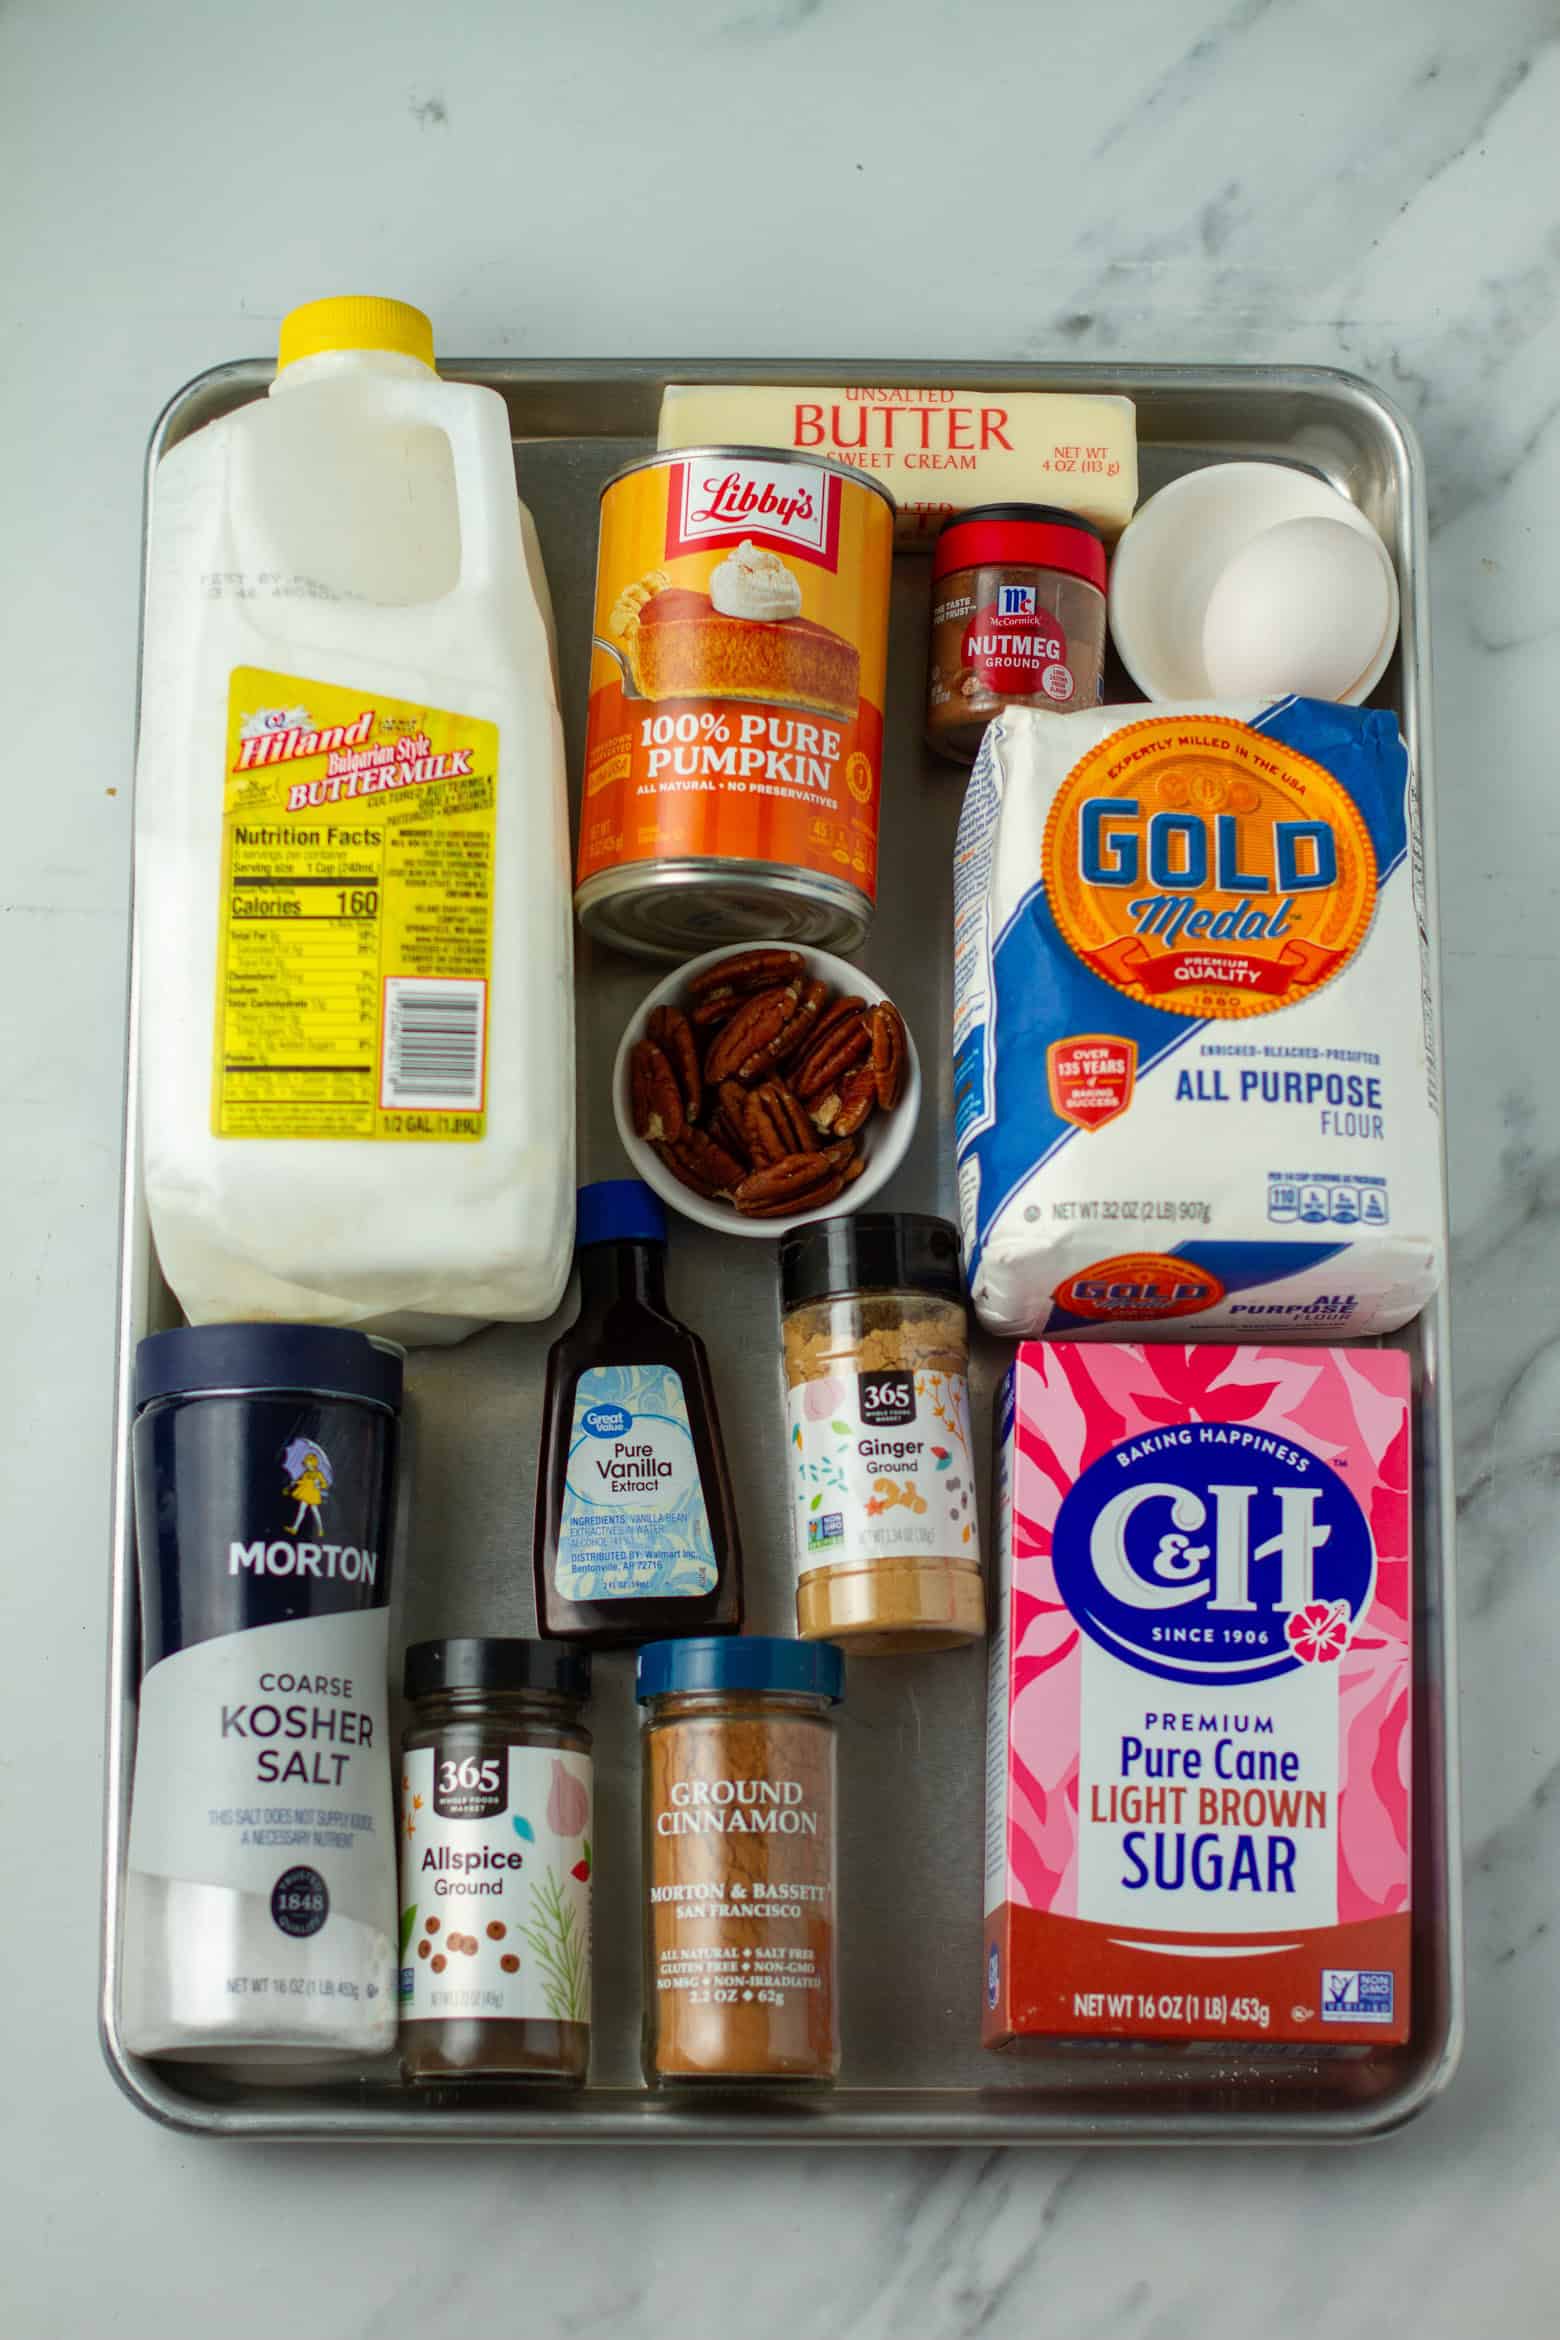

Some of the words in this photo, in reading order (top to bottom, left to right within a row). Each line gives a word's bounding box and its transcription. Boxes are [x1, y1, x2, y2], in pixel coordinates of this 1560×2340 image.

[845, 386, 954, 403] UNSALTED
[793, 404, 1014, 450] BUTTER
[904, 454, 977, 469] CREAM
[1054, 447, 1082, 460] NET
[1086, 448, 1109, 460] WT
[1042, 459, 1049, 472] 4
[1054, 461, 1077, 473] OZ
[690, 472, 813, 526] Libby's
[989, 616, 1041, 626] McCormick
[968, 635, 1060, 660] NUTMEG
[985, 657, 1040, 669] GROUND
[233, 711, 376, 773] Hiland
[641, 713, 730, 746] 100%
[740, 714, 841, 761] PURE
[327, 743, 397, 777] Bulgarian
[396, 732, 432, 762] Style
[647, 747, 833, 790] PUMPKIN
[1106, 737, 1173, 780] EXPERTLY
[1178, 736, 1231, 750] MILLED
[1236, 745, 1249, 758] IN
[1253, 754, 1279, 776] THE
[1280, 772, 1307, 796] USA
[286, 749, 473, 812] BUTTERMILK
[637, 783, 657, 795] ALL
[659, 780, 716, 791] NATURAL
[727, 782, 746, 792] NO
[749, 783, 839, 810] PRESERVATIVES
[234, 827, 320, 846] Nutrition
[327, 828, 382, 846] Facts
[1077, 796, 1339, 895] GOLD
[232, 896, 302, 915] Calories
[337, 890, 378, 915] 160
[1126, 895, 1295, 949] Medal
[1183, 957, 1249, 968] PREMIUM
[1173, 966, 1262, 983] QUALITY
[1073, 1048, 1110, 1060] OVER
[1058, 1062, 1080, 1076] 135
[1082, 1059, 1125, 1075] YEARS
[1176, 1069, 1230, 1101] ALL
[1240, 1070, 1383, 1110] PURPOSE
[1320, 1110, 1384, 1141] FLOUR
[1052, 1201, 1077, 1220] NET
[1080, 1201, 1099, 1219] WT
[1102, 1201, 1120, 1220] 32
[1121, 1201, 1138, 1220] OZ
[1179, 1201, 1212, 1224] 907g
[1071, 1280, 1211, 1300] GOLD
[1313, 1295, 1360, 1305] ALL
[1229, 1304, 1354, 1315] PURPOSE
[864, 1382, 910, 1409] 365
[587, 1412, 624, 1425] Great
[596, 1423, 625, 1432] Value
[614, 1443, 653, 1458] Pure
[858, 1438, 925, 1459] Ginger
[1115, 1429, 1193, 1468] BAKING
[1200, 1428, 1311, 1473] HAPPINESS
[595, 1458, 673, 1479] Vanilla
[866, 1458, 919, 1474] Ground
[611, 1480, 659, 1493] Extract
[571, 1551, 626, 1562] DISTRIBUTED
[1090, 1482, 1332, 1612] C&H
[228, 1541, 379, 1586] MORTON
[1151, 1627, 1215, 1643] SINCE
[1224, 1628, 1270, 1645] 1906
[259, 1673, 353, 1699] COARSE
[221, 1704, 374, 1749] KOSHER
[1145, 1712, 1274, 1734] PREMIUM
[255, 1750, 350, 1787] SALT
[1120, 1736, 1202, 1780] Pure
[1214, 1738, 1300, 1782] Cane
[438, 1756, 500, 1793] 365
[670, 1780, 803, 1806] GROUND
[1091, 1785, 1188, 1825] LIGHT
[1199, 1787, 1328, 1829] BROWN
[657, 1809, 818, 1836] CINNAMON
[421, 1847, 524, 1876] Allspice
[1120, 1831, 1297, 1893] SUGAR
[433, 1878, 504, 1896] Ground
[650, 1884, 725, 1903] MORTON
[730, 1884, 748, 1900] &
[753, 1883, 826, 1902] BASSETT
[278, 1893, 323, 1912] 1848
[676, 1904, 706, 1920] SAN
[709, 1904, 802, 1919] FRANCISCO
[660, 1951, 678, 1961] ALL
[680, 1948, 738, 1960] NATURAL
[755, 1948, 786, 1959] SALT
[660, 1962, 703, 1974] GLUTEN
[706, 1961, 738, 1973] FREE
[754, 1961, 816, 1973] NON-GMO
[714, 1975, 821, 1988] NON-IRRADIATED
[1360, 1975, 1389, 1985] NON
[1360, 1984, 1390, 1995] GMO
[714, 1989, 738, 2002] OZ
[758, 1990, 785, 2006] 62g
[1074, 1993, 1104, 2017] NET
[1107, 1994, 1134, 2018] WT
[1137, 1994, 1156, 2019] 16
[1158, 1995, 1184, 2020] OZ
[1186, 1994, 1199, 2025] (1
[1204, 1996, 1228, 2025] LB)
[1230, 1998, 1270, 2029] 453g
